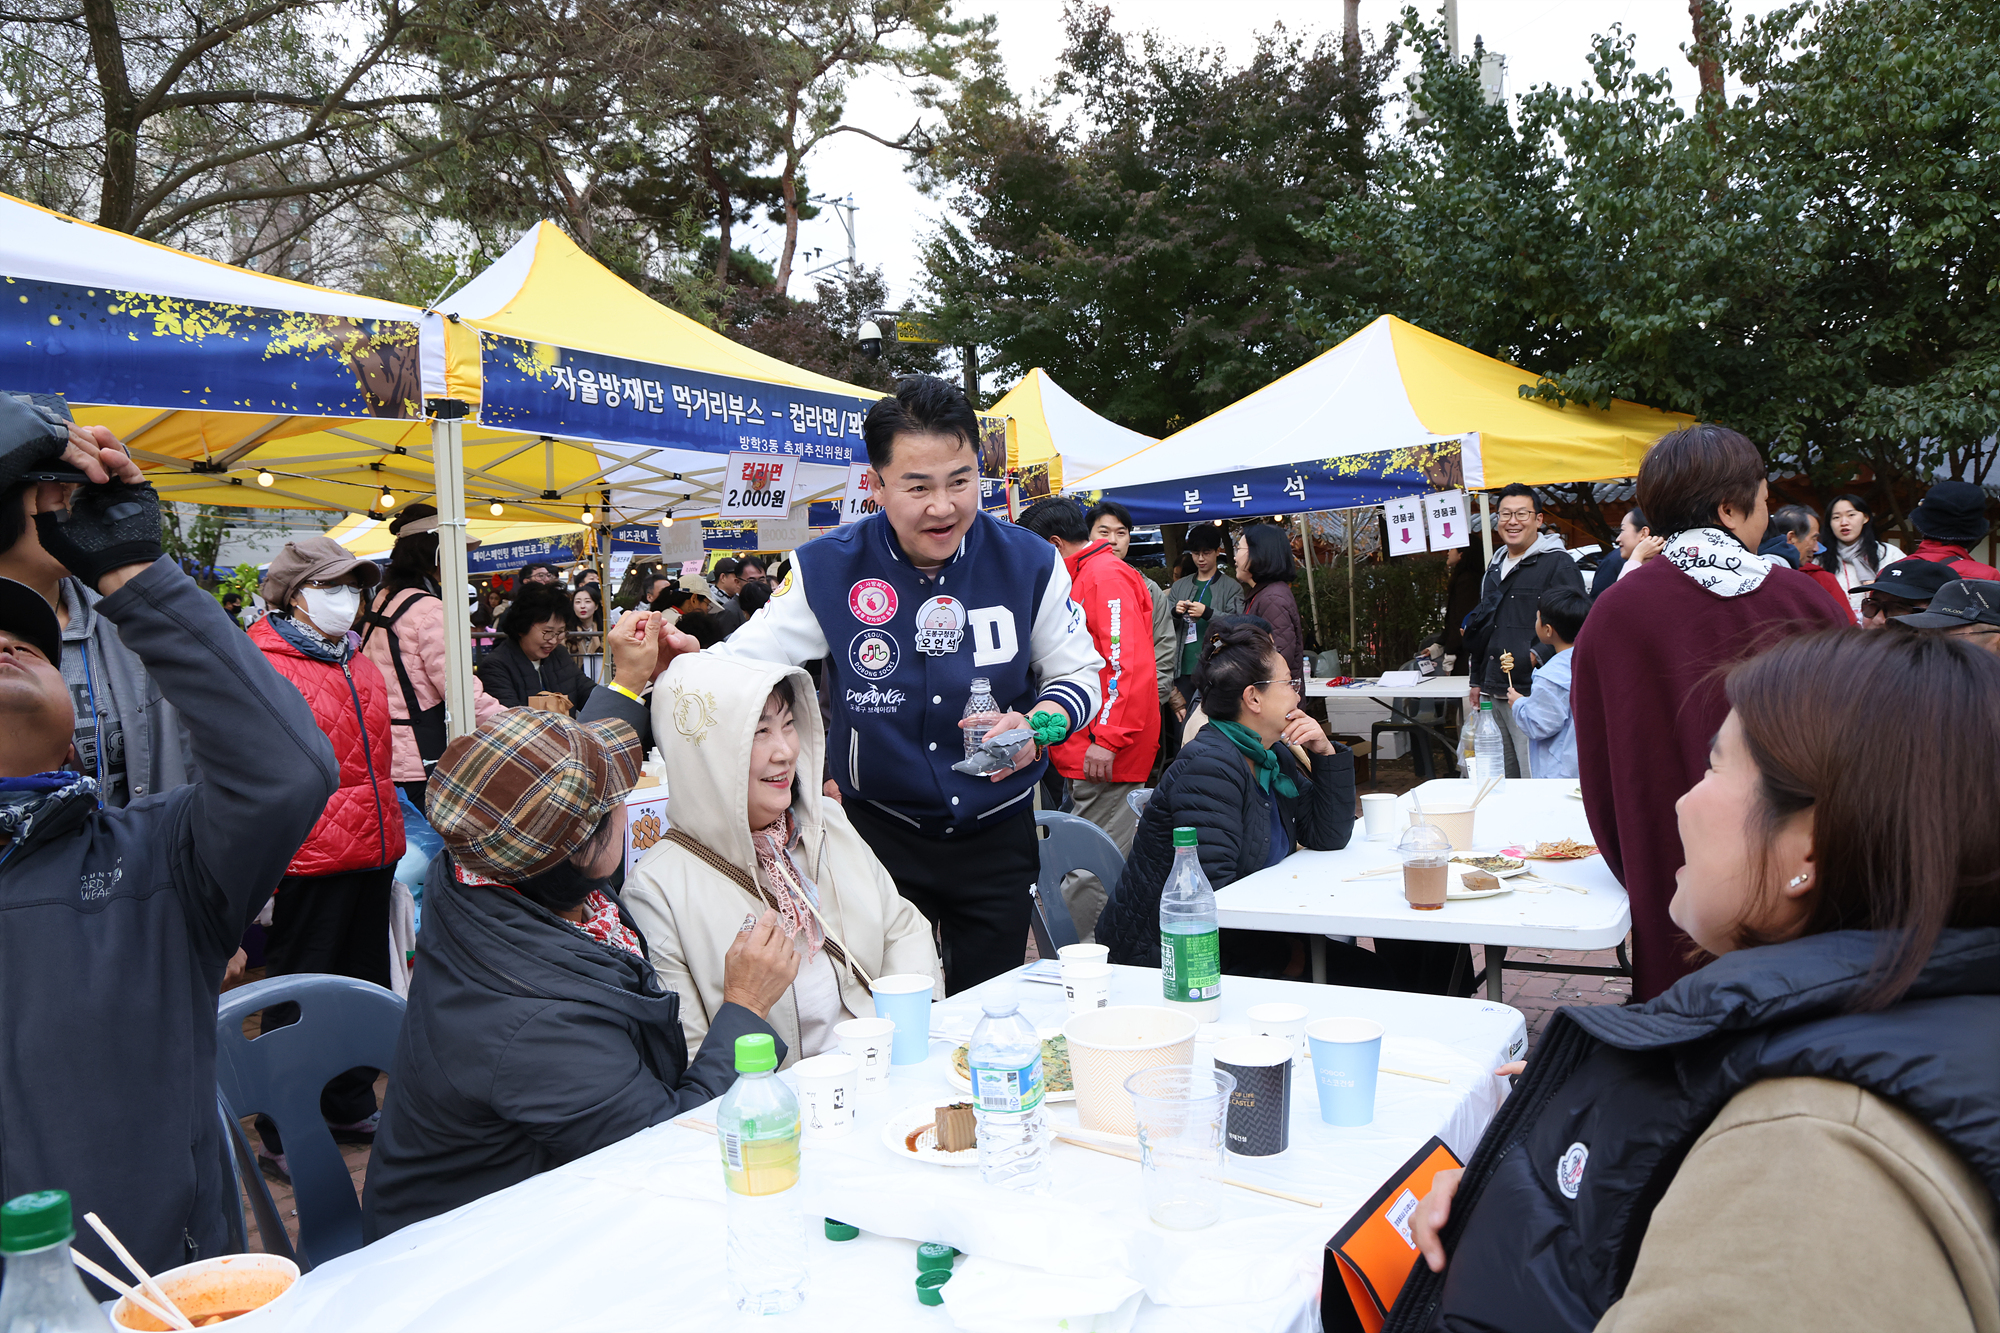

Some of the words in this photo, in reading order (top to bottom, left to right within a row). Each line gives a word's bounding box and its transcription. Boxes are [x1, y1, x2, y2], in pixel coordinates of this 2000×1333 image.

[551, 366, 664, 413] 자율방재단
[671, 384, 765, 425] 먹거리부스
[789, 402, 867, 440] 컵라면/꽈
[739, 435, 779, 453] 방학3동
[783, 441, 853, 461] 축제추진위원회
[741, 462, 784, 482] 컵라면
[980, 480, 993, 497] 램
[727, 489, 786, 509] 2,000원
[1392, 512, 1415, 524] 경품권
[1433, 506, 1457, 519] 경품권
[619, 529, 648, 543] 비즈공예
[473, 547, 509, 562] 페이스페인팅
[511, 542, 551, 558] 체험프로그램
[925, 630, 956, 638] 도봉구청장
[967, 604, 1019, 668] D
[854, 661, 878, 677] DOBONG
[879, 661, 895, 677] SOCKS
[850, 703, 866, 712] 도봉구
[1232, 1099, 1255, 1107] CASTLE
